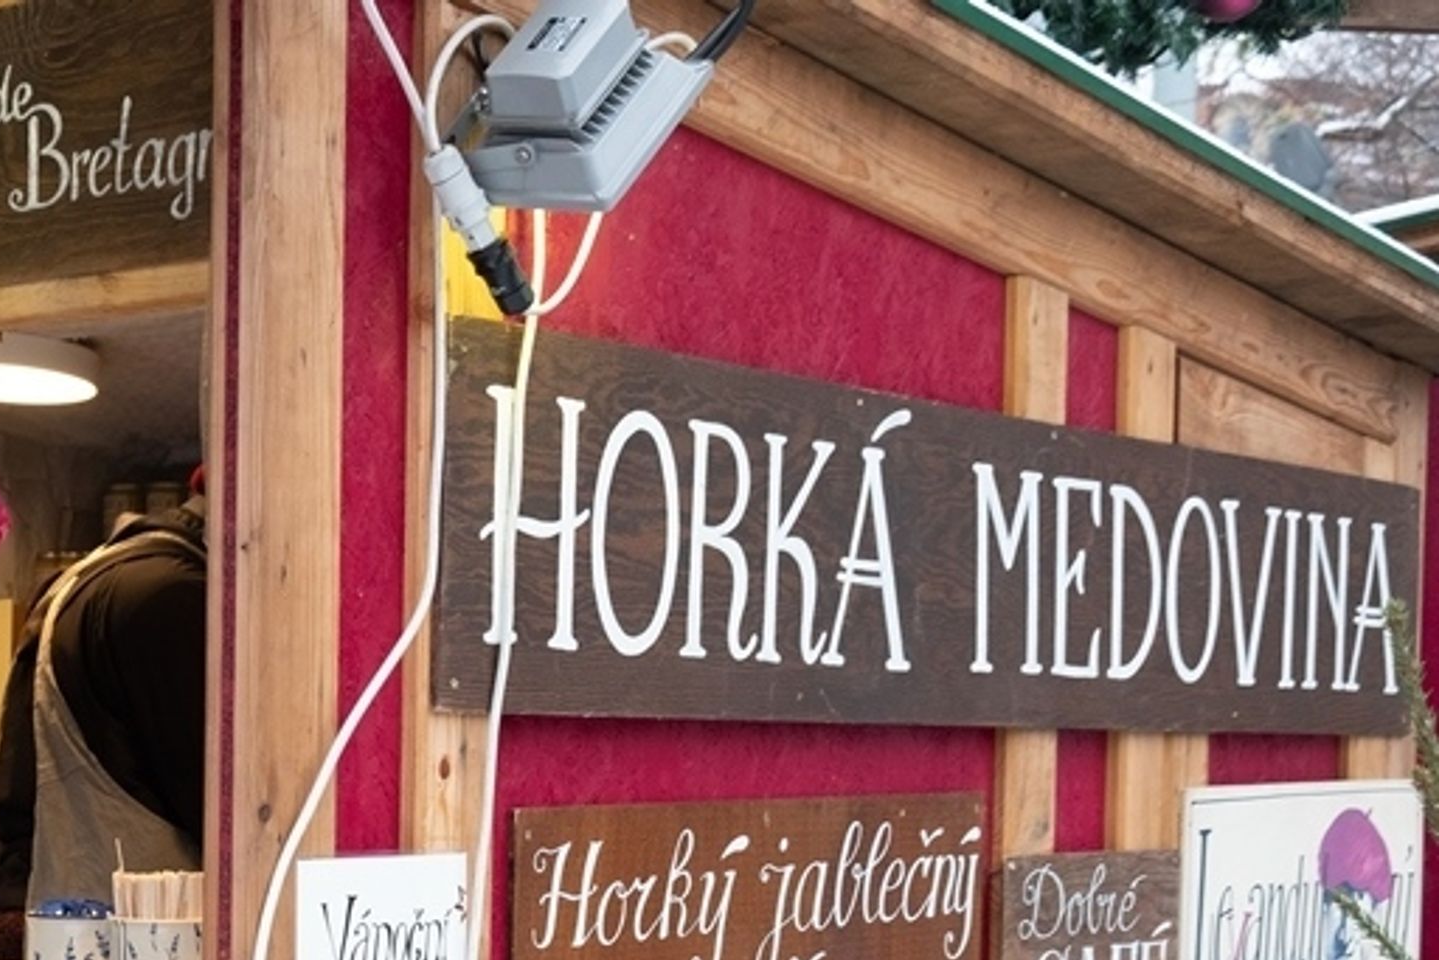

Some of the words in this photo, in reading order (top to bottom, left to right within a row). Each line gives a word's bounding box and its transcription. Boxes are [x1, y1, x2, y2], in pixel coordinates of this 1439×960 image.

[478, 384, 913, 674] HORKÁ
[969, 461, 1399, 694] MEDOVINA
[1018, 863, 1147, 940] Dobré
